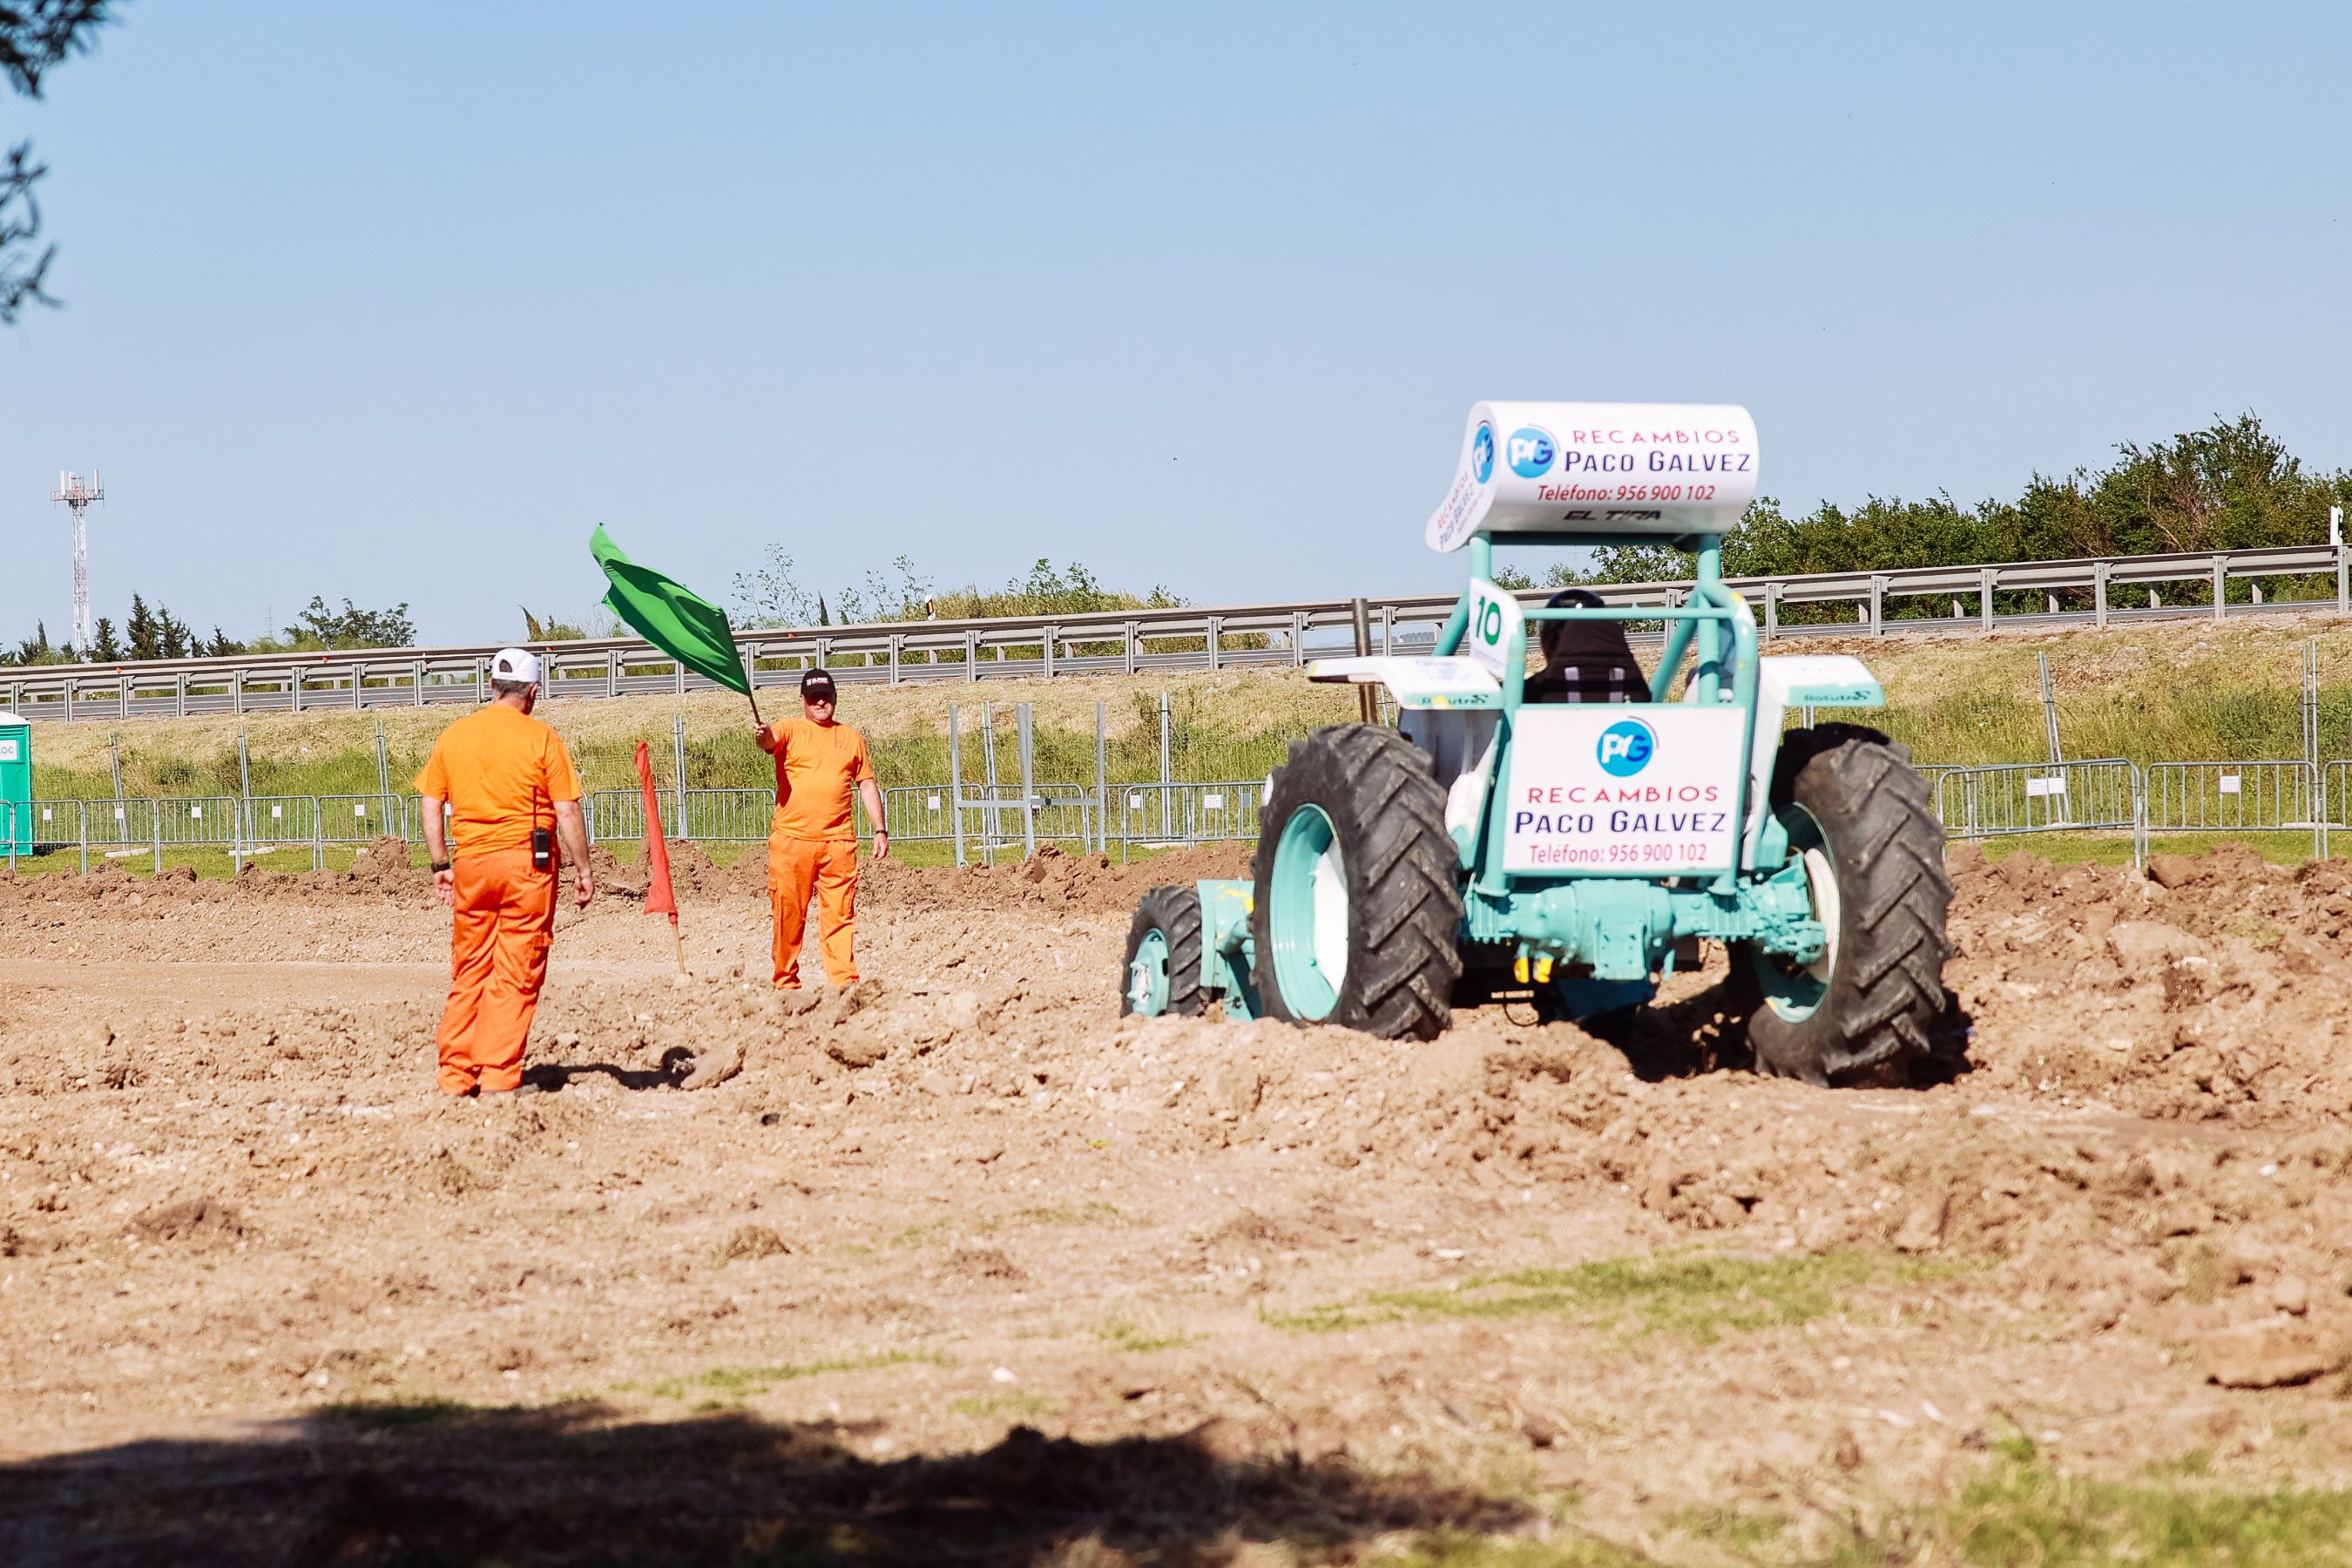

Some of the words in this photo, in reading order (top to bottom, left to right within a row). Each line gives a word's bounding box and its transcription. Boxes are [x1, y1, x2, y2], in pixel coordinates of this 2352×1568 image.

[1572, 429, 1740, 444] RECAMBIOS
[1565, 450, 1634, 472] PACO
[1648, 450, 1750, 472] GALVEZ
[1538, 483, 1612, 501] Teléfono:
[1617, 484, 1647, 501] 956
[1651, 484, 1681, 501] 900
[1686, 484, 1715, 501] 102
[1564, 510, 1596, 521] EL
[1477, 596, 1501, 645] 10
[1528, 787, 1718, 804] RECAMBIOS
[1515, 811, 1594, 834] PACO
[1611, 810, 1727, 833] GALVEZ
[1531, 843, 1605, 863] Teléfono:
[1610, 844, 1639, 862] 956
[1644, 844, 1673, 862] 900
[1680, 843, 1707, 862] 102
